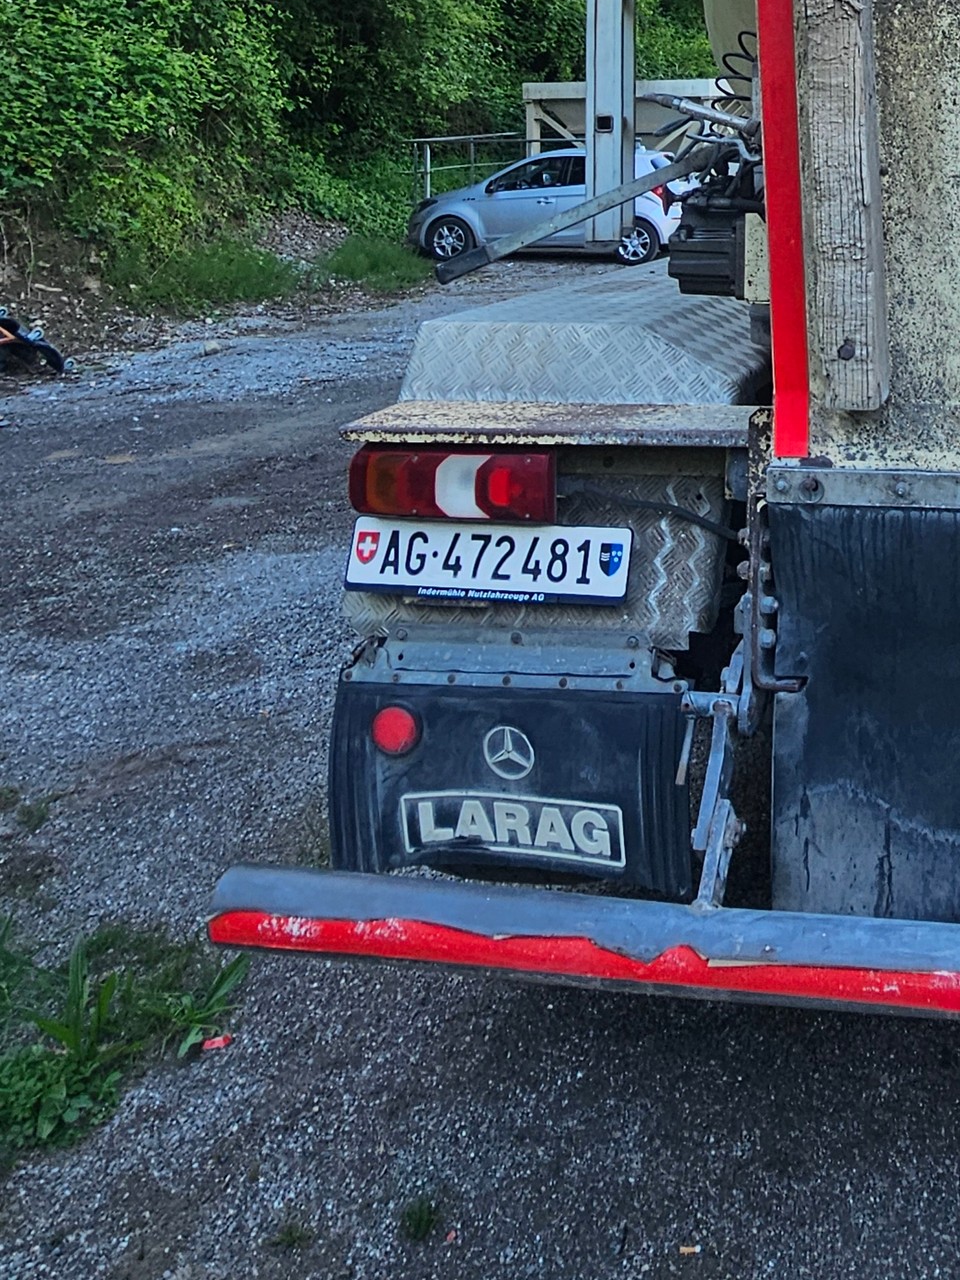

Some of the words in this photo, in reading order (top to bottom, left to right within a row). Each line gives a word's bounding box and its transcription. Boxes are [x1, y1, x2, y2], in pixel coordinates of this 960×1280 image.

[417, 587, 466, 598] Indermühle
[467, 589, 530, 601] Nutzfahrzeuge
[531, 593, 545, 601] AG
[417, 799, 612, 857] LARAG
